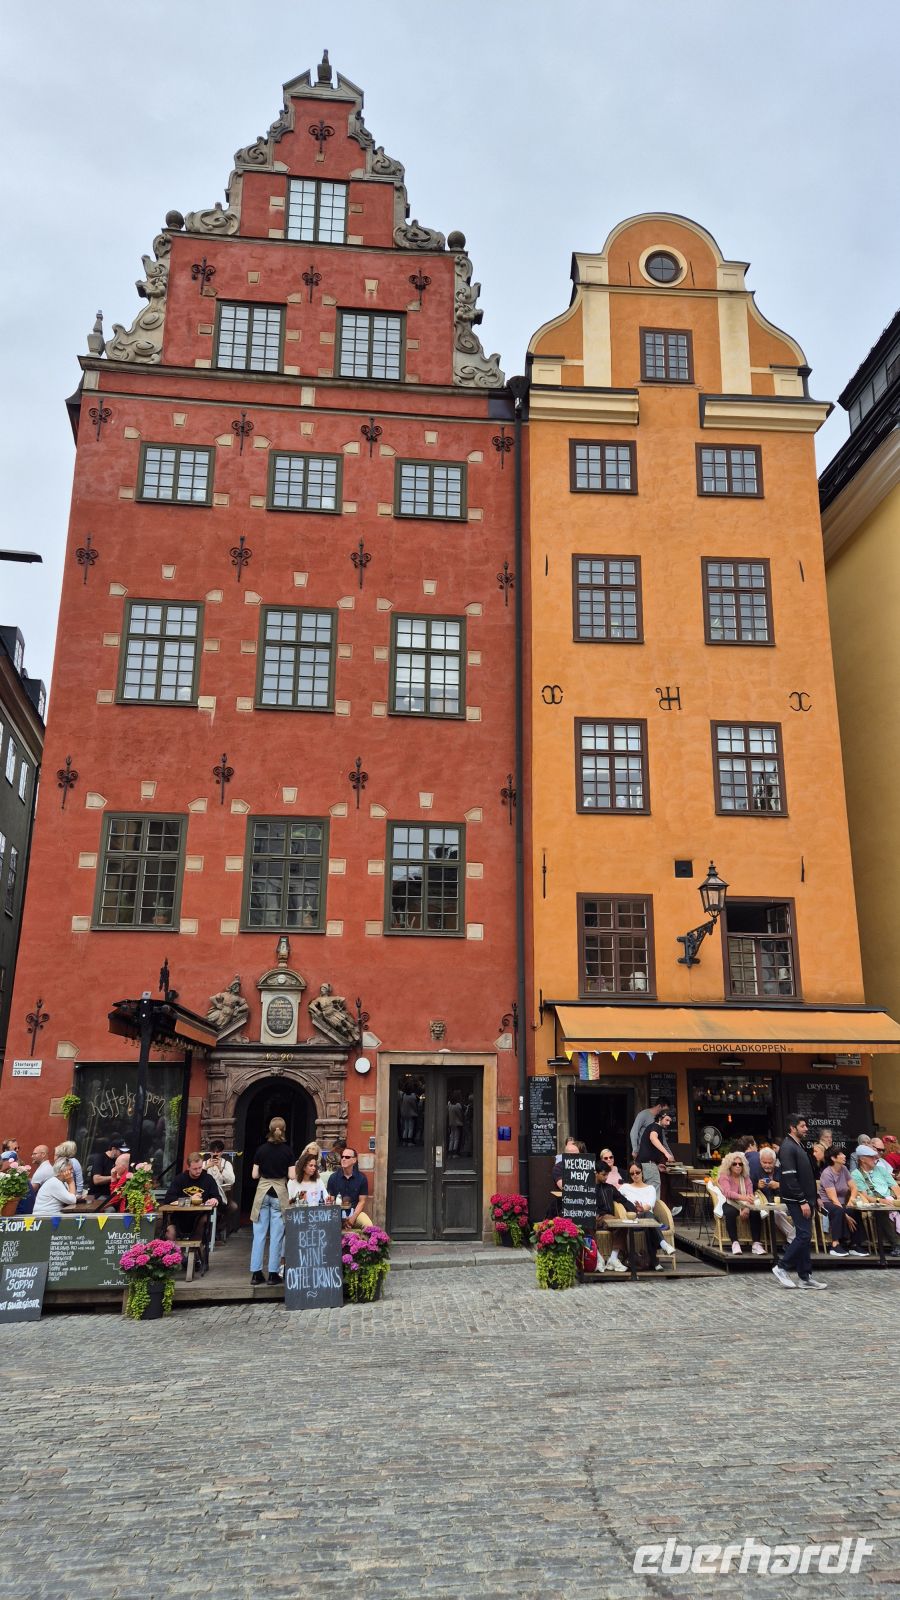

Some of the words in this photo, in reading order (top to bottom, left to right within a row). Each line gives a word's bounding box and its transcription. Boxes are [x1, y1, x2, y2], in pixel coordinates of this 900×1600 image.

[703, 1044, 787, 1053] CHOKLADKOPPEN
[293, 1211, 306, 1225] WE
[308, 1209, 332, 1223] SERVE
[298, 1247, 328, 1268] WINE
[5, 1266, 39, 1281] DAGENS
[286, 1267, 311, 1290] COFFEE
[312, 1266, 342, 1291] DRINKS
[6, 1279, 35, 1291] SOPPA
